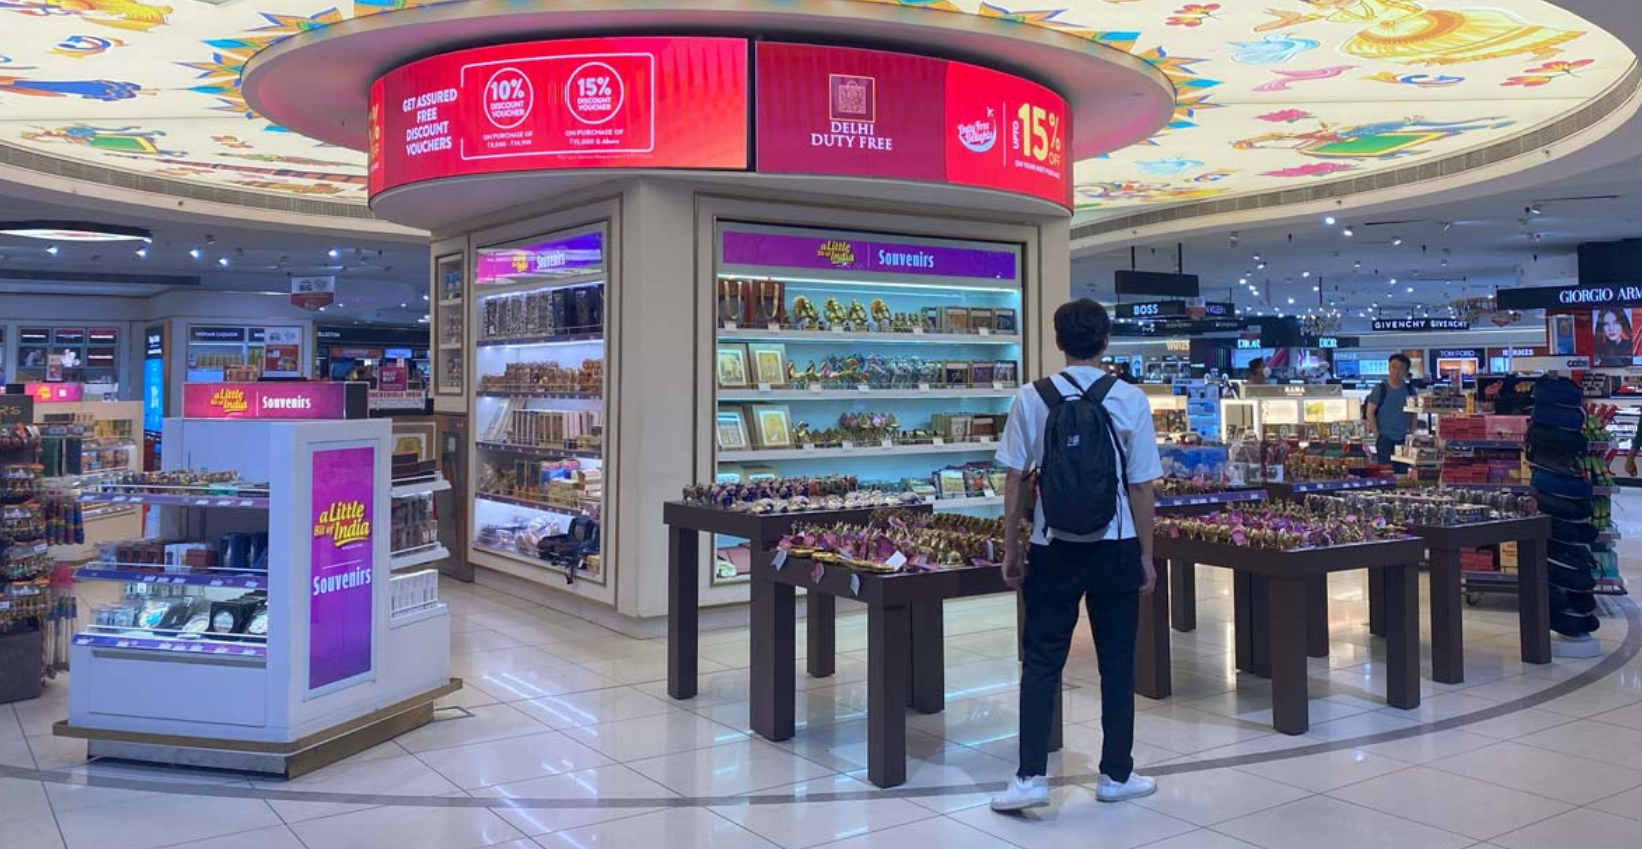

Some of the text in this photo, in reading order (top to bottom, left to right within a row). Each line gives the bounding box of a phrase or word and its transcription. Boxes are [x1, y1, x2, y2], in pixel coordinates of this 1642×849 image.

[490, 78, 525, 101] 10%
[577, 77, 612, 97] 15%
[402, 88, 458, 113] GET ASSURED
[490, 101, 524, 110] DISCOUNT
[577, 97, 611, 105] DISCOUNT
[417, 107, 437, 123] FREE
[491, 109, 525, 118] VOUCHER
[406, 120, 449, 141] DISCOUNT
[493, 131, 523, 139] PURCHASE
[830, 121, 874, 136] DELHI
[1012, 120, 1020, 149] UPTO
[406, 136, 452, 156] VOUCHERS
[811, 132, 892, 150] DUTY FREE
[1048, 151, 1060, 168] OFF
[878, 249, 934, 269] Souvenirs
[1559, 288, 1613, 304] GIORGIO
[1133, 304, 1159, 315] BOSS
[1374, 320, 1467, 329] GIVENCHY GIVENCHY
[1319, 338, 1338, 348] DIOR
[220, 388, 244, 400] Little
[262, 395, 311, 409] Souvenirs
[222, 399, 248, 411] India
[320, 501, 364, 524] a Little
[333, 518, 369, 541] India
[313, 566, 371, 596] Souvenirs
